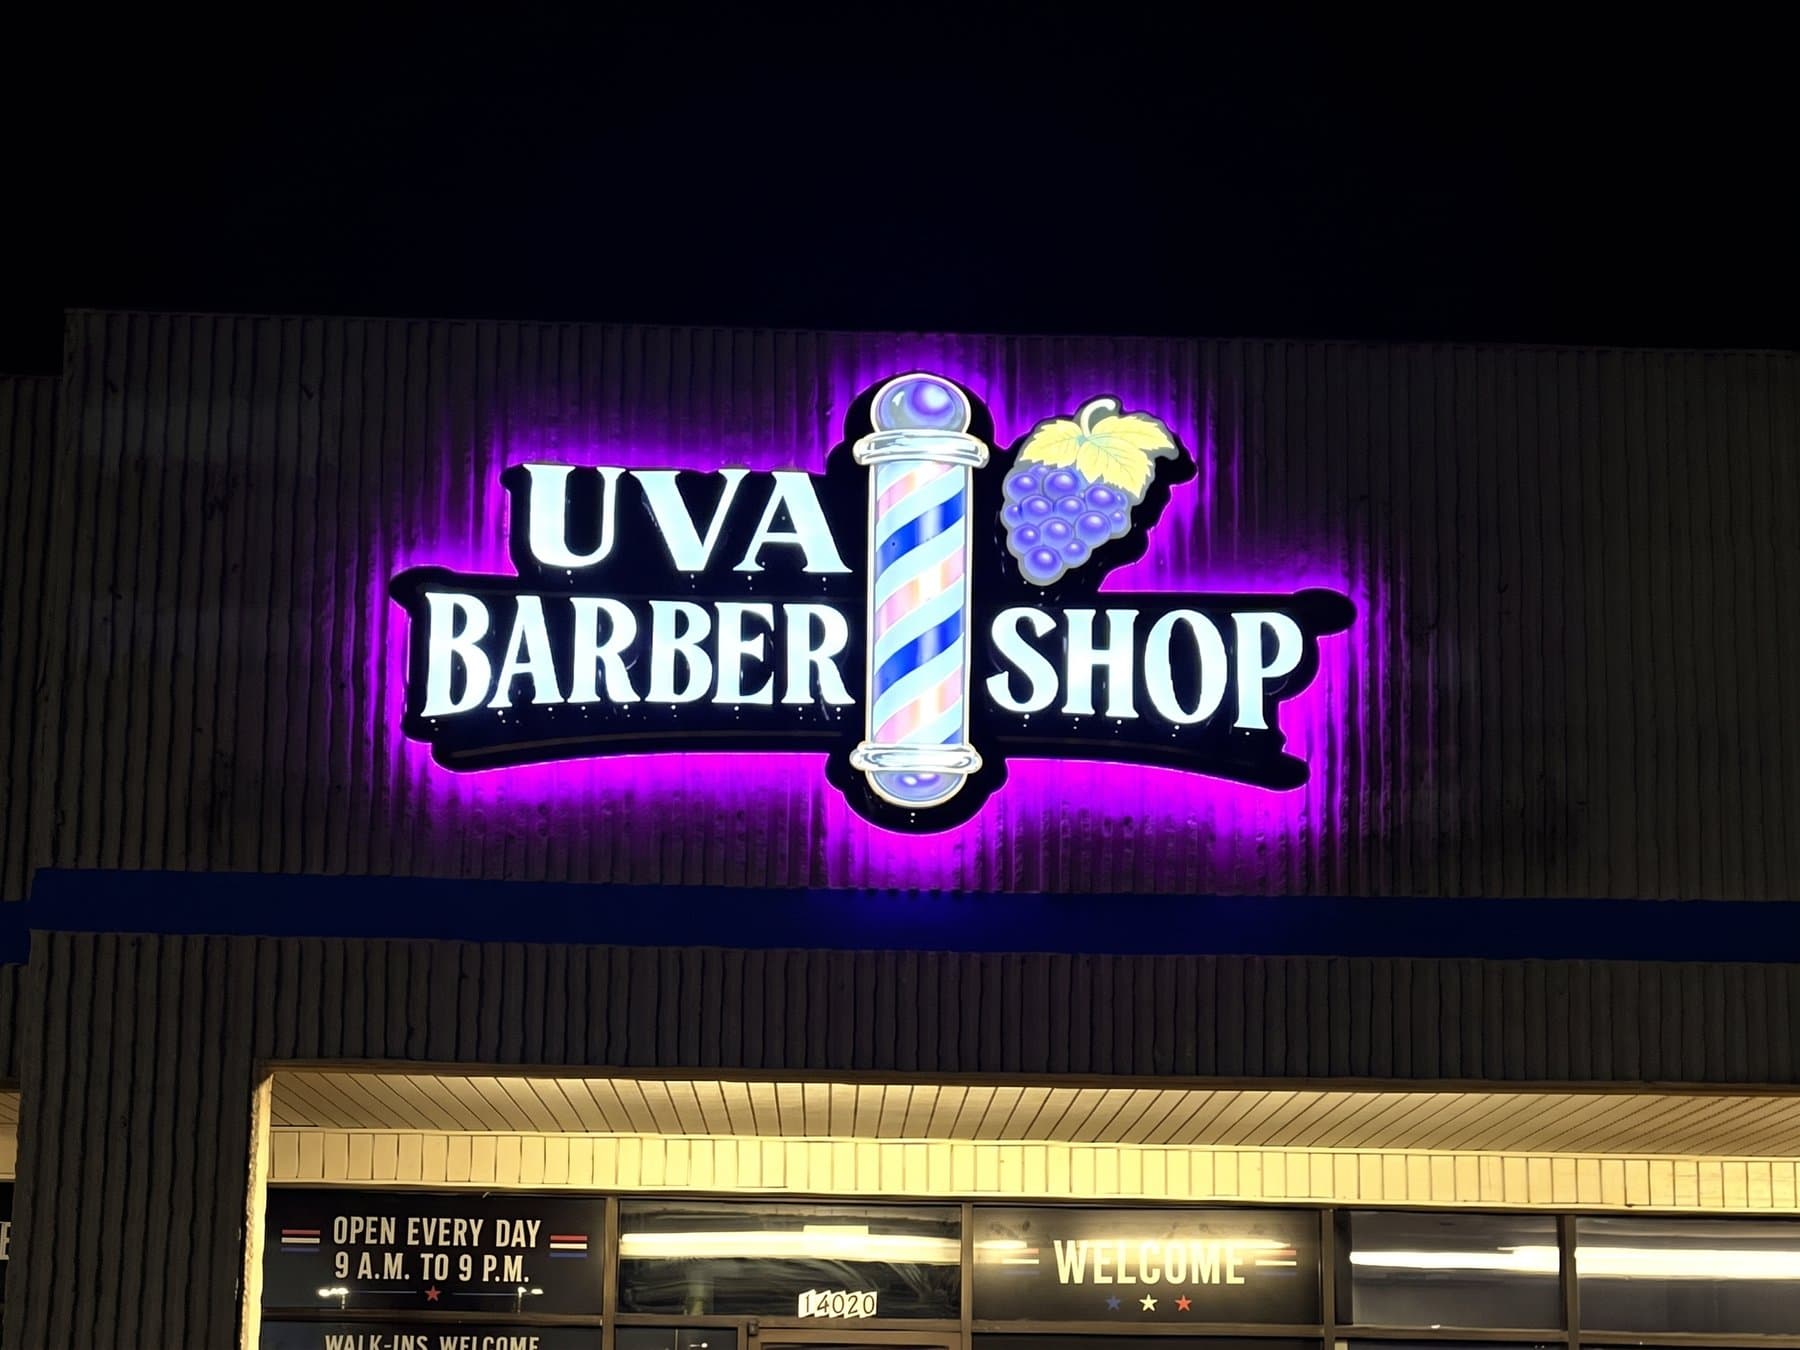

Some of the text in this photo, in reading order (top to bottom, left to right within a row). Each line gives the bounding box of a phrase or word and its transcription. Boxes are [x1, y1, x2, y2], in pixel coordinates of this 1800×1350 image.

[523, 463, 853, 573] UVA
[421, 592, 1303, 730] BARBER SHOP
[333, 1216, 541, 1248] OPEN EVERY DAY
[335, 1251, 529, 1282] 9 A.M. TO 9 P.M.
[1053, 1239, 1245, 1285] WELCOME
[803, 1293, 876, 1315] 14020
